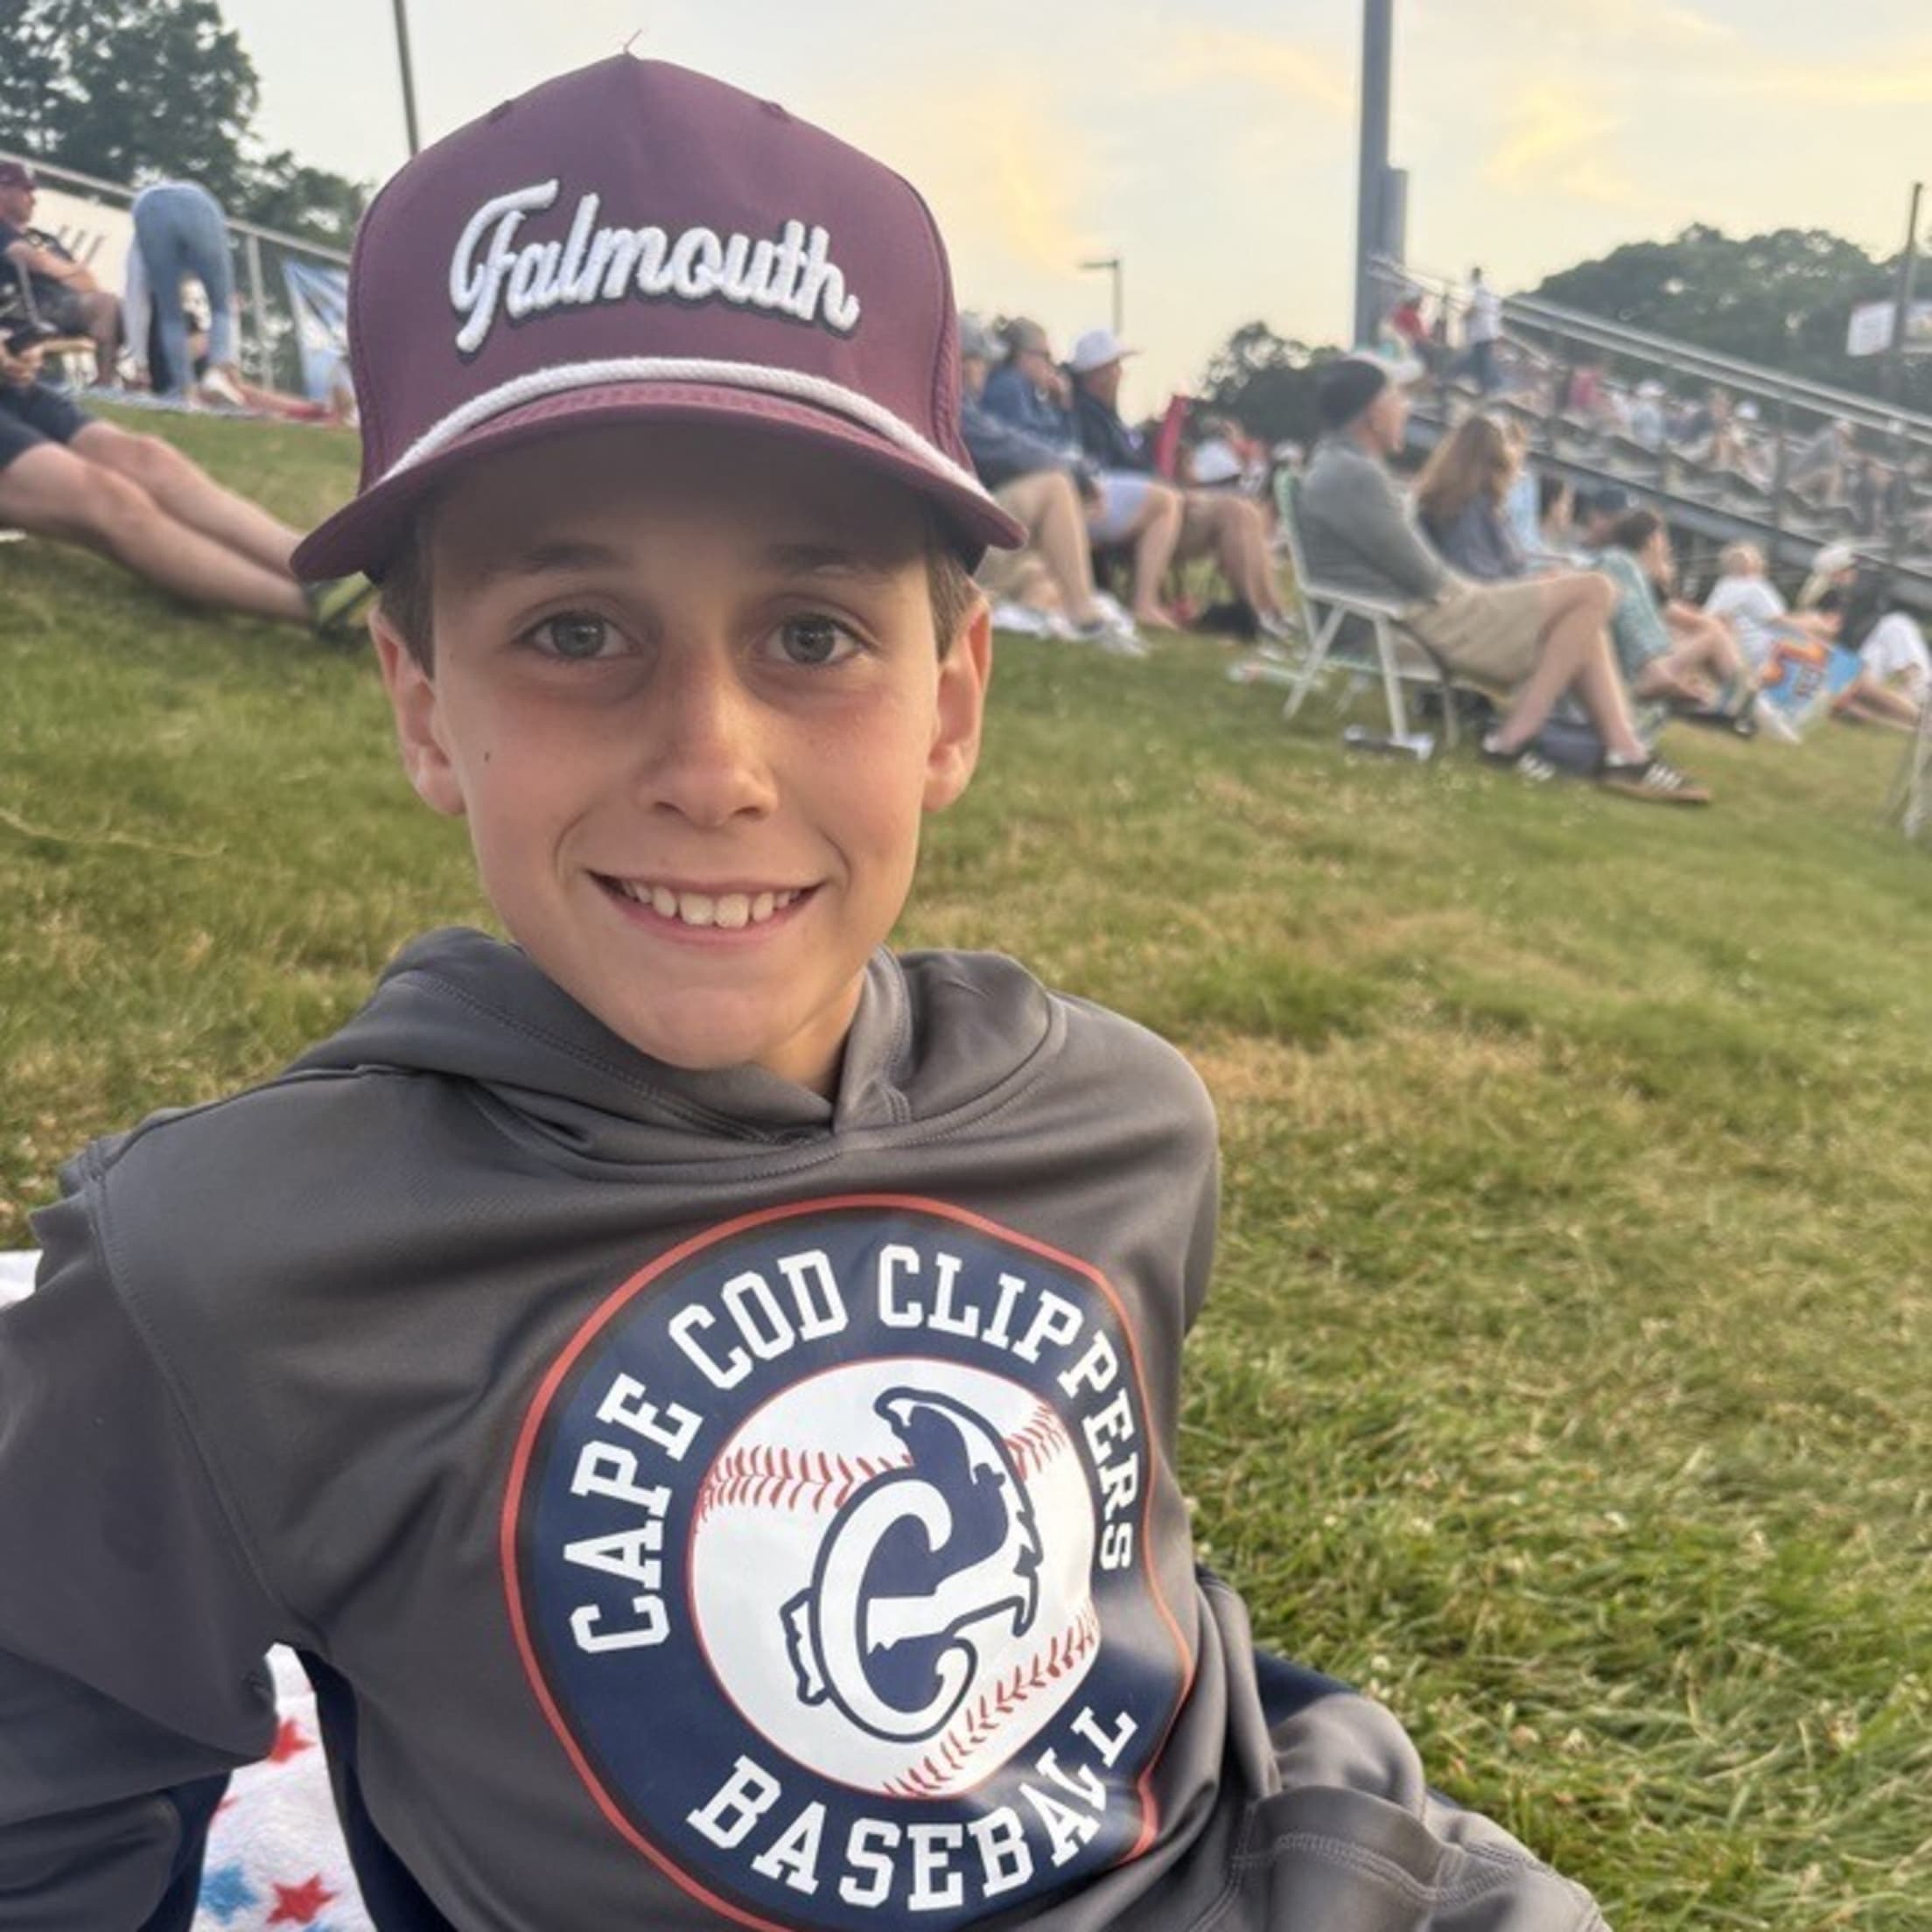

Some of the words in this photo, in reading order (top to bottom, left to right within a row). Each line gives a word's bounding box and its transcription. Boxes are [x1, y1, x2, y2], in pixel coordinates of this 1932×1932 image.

[450, 178, 860, 352] Falmouth
[564, 1374, 703, 1654] CAPE
[669, 1250, 849, 1390] COD
[878, 1244, 1135, 1572] CLIPPERS
[687, 1707, 1137, 1911] BASEBALL
